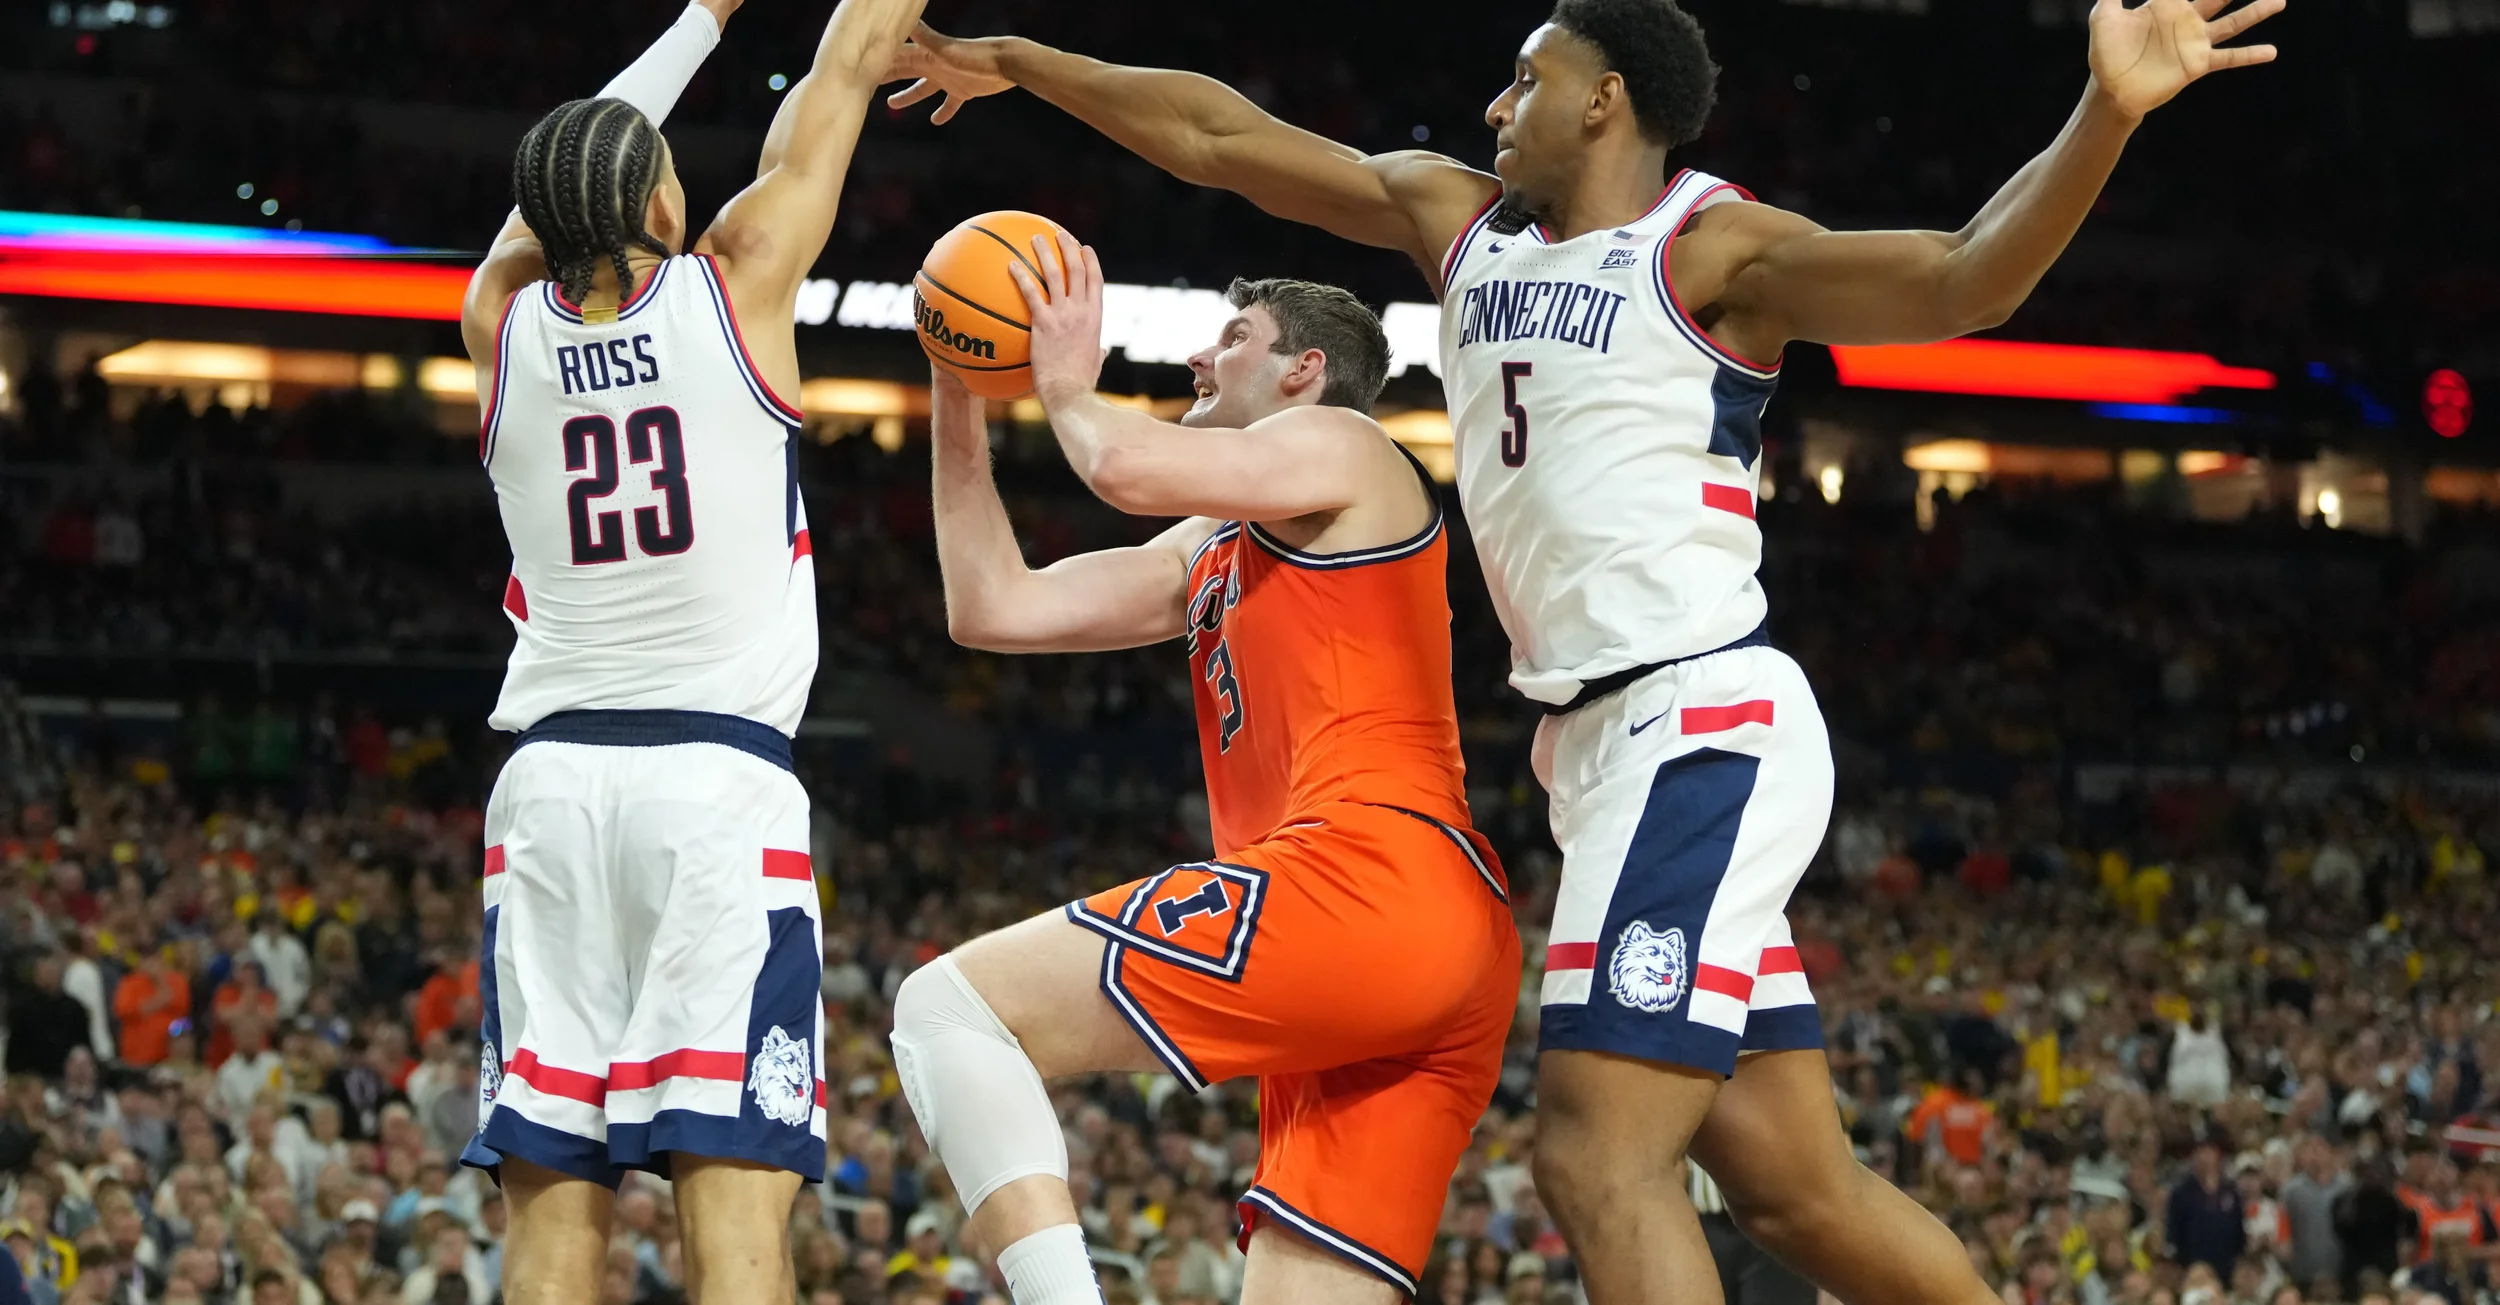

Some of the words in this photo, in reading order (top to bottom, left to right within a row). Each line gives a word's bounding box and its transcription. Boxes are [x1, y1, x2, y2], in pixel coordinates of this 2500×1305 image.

[1602, 257, 1639, 266] EAST
[1608, 249, 1635, 258] BIG
[1458, 280, 1627, 354] CONNECTICUT
[557, 333, 660, 395] ROSS
[1501, 361, 1533, 468] 5
[562, 405, 695, 566] 23
[1206, 636, 1244, 755] 3
[1153, 876, 1231, 937] I
